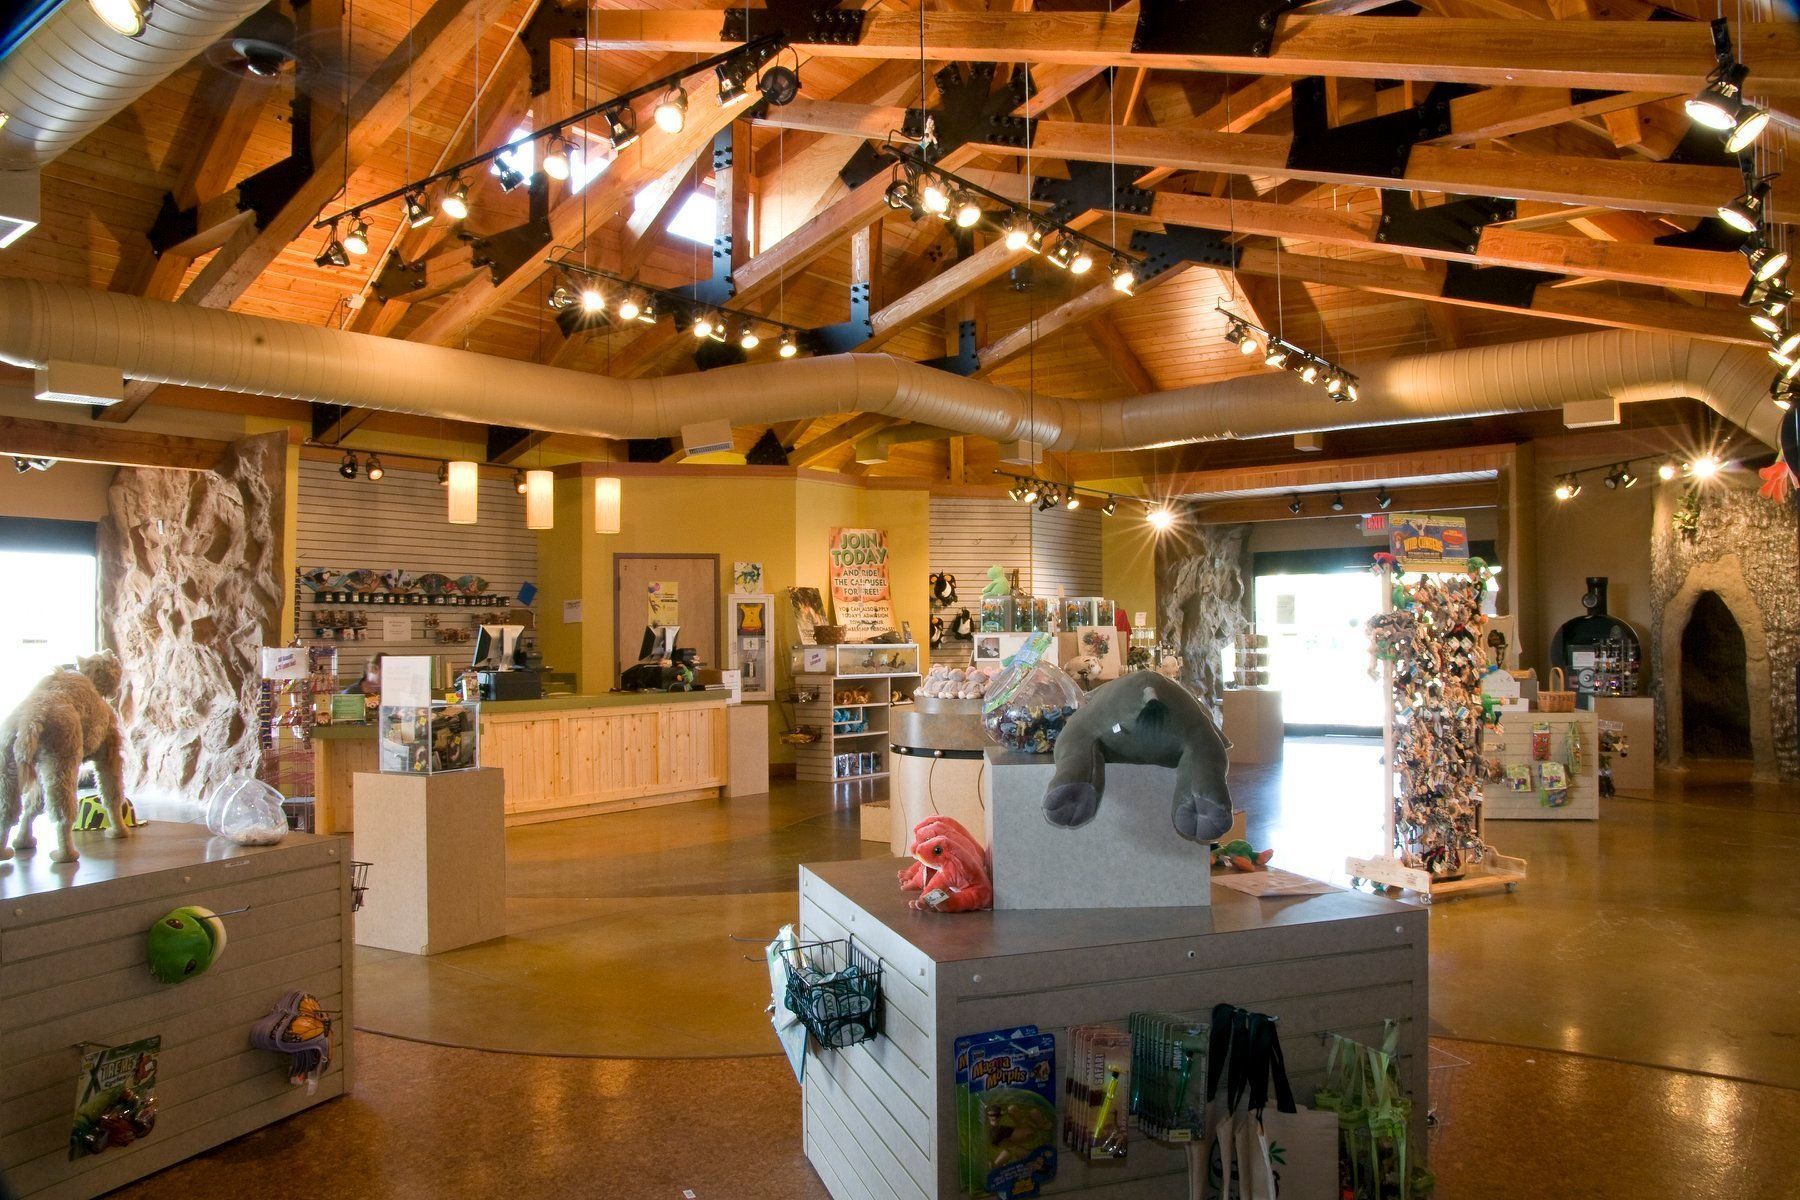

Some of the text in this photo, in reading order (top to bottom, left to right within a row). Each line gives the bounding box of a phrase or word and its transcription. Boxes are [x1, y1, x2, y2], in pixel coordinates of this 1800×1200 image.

[1366, 516, 1384, 530] EXIT
[840, 533, 877, 549] JOIN
[832, 547, 887, 566] TODAY
[834, 578, 848, 586] THE
[986, 1065, 1028, 1090] Morphs
[1094, 1053, 1105, 1085] SAFARI
